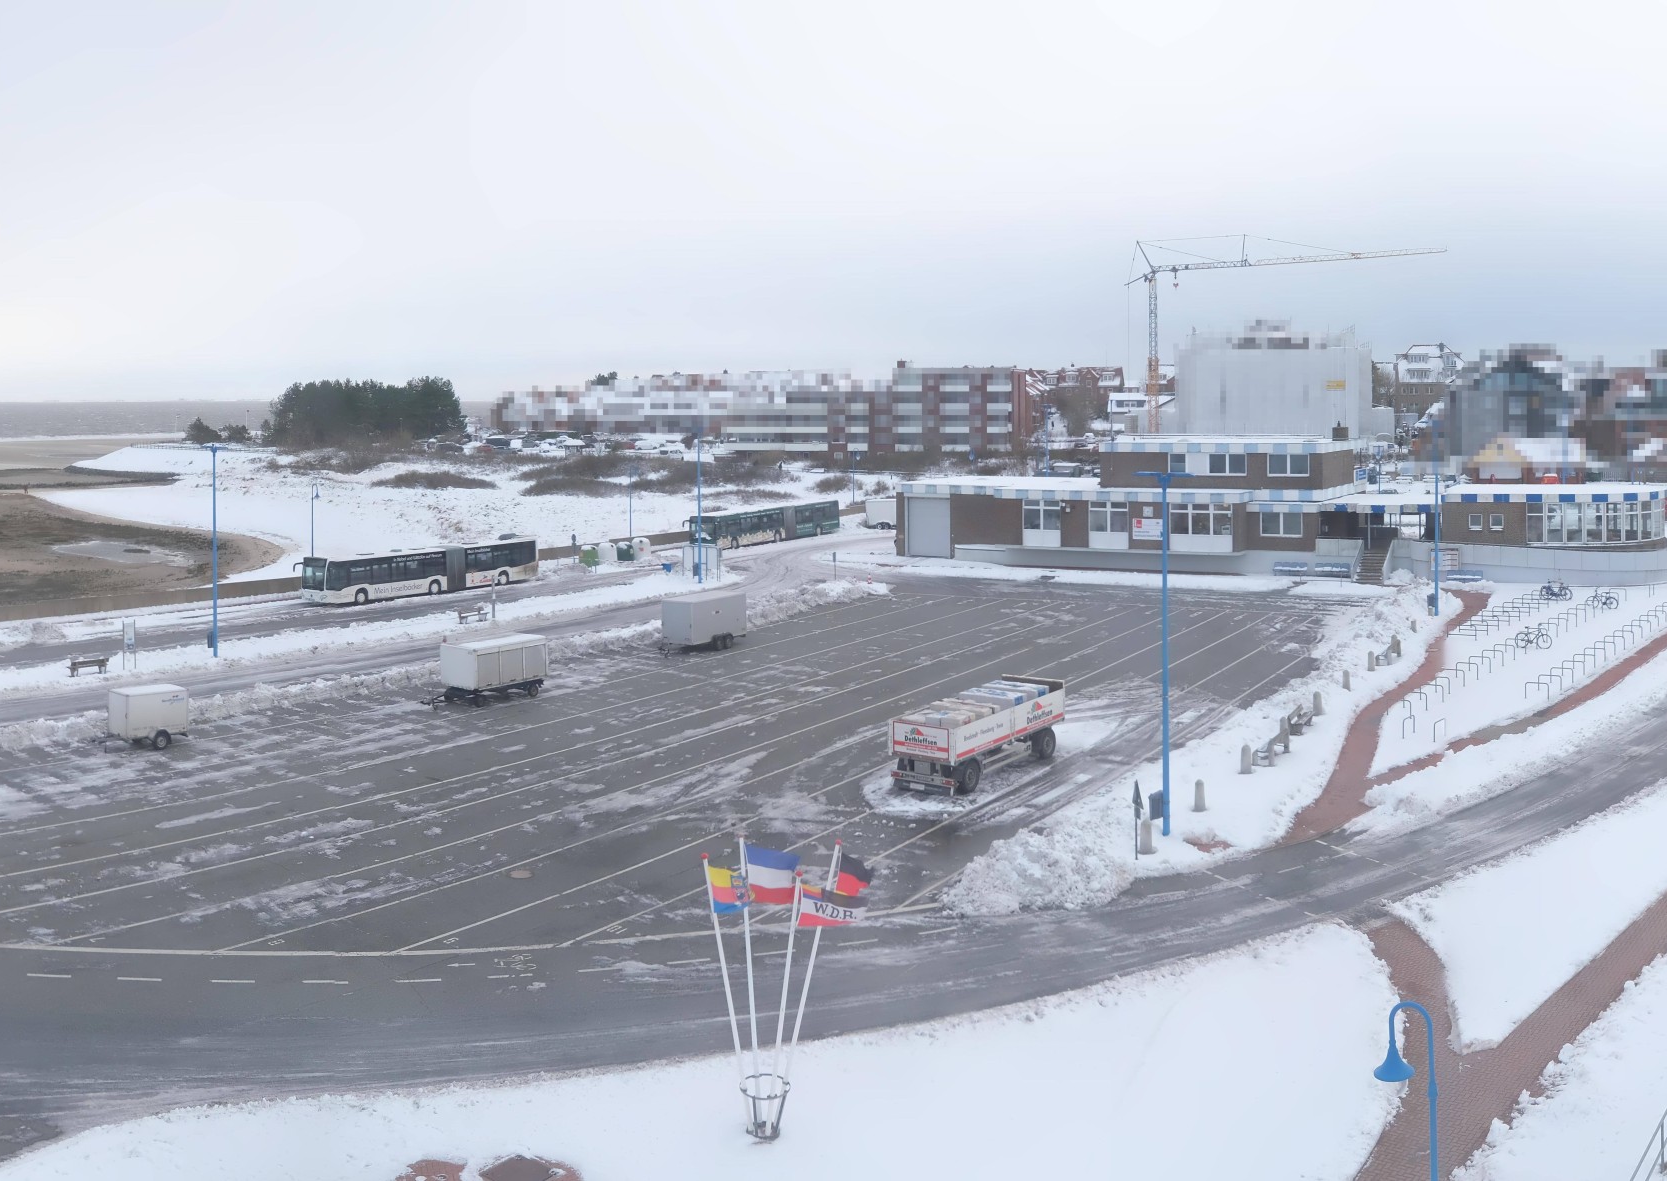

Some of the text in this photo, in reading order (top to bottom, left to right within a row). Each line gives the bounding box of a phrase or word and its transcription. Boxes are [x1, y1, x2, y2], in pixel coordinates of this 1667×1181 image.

[374, 586, 390, 595] Mein
[1027, 709, 1053, 726] Dethleffsen
[904, 735, 938, 746] Dethleffsen
[813, 901, 857, 920] W.D.R.
